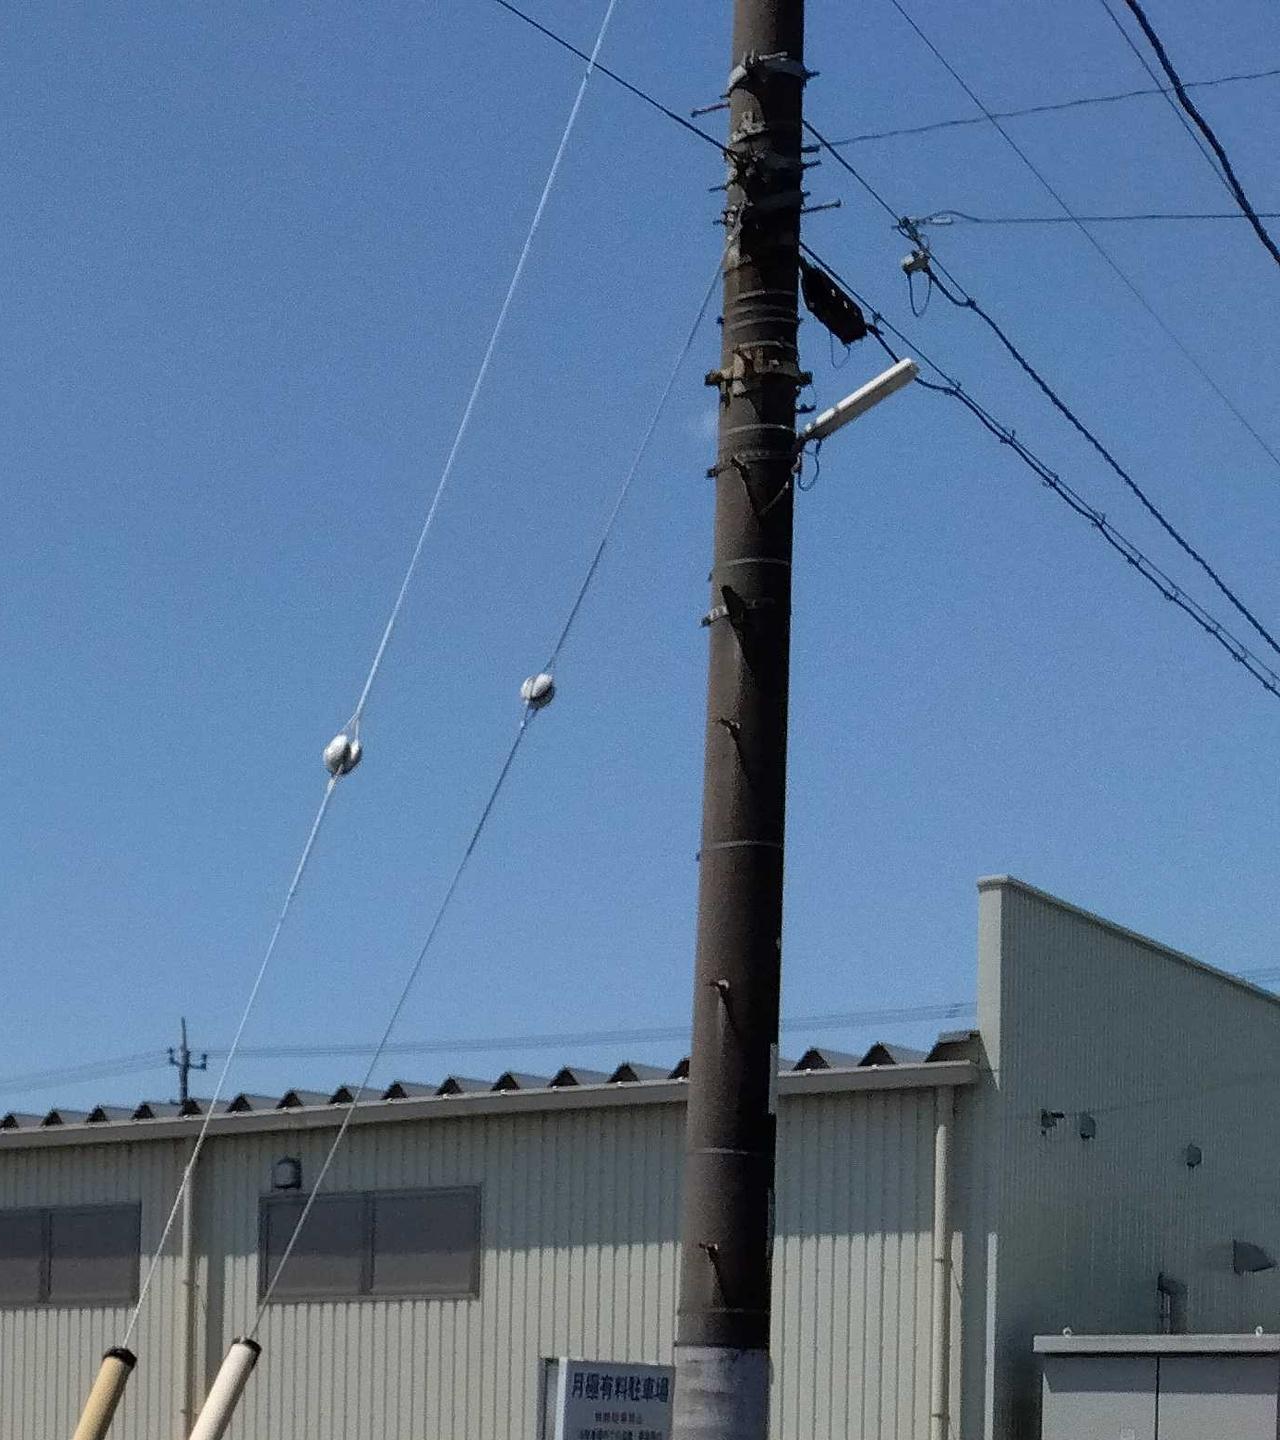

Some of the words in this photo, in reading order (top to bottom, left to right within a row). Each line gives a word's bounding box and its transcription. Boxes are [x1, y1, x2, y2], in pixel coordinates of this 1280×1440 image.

[572, 1372, 669, 1402] 月極有料駐車場
